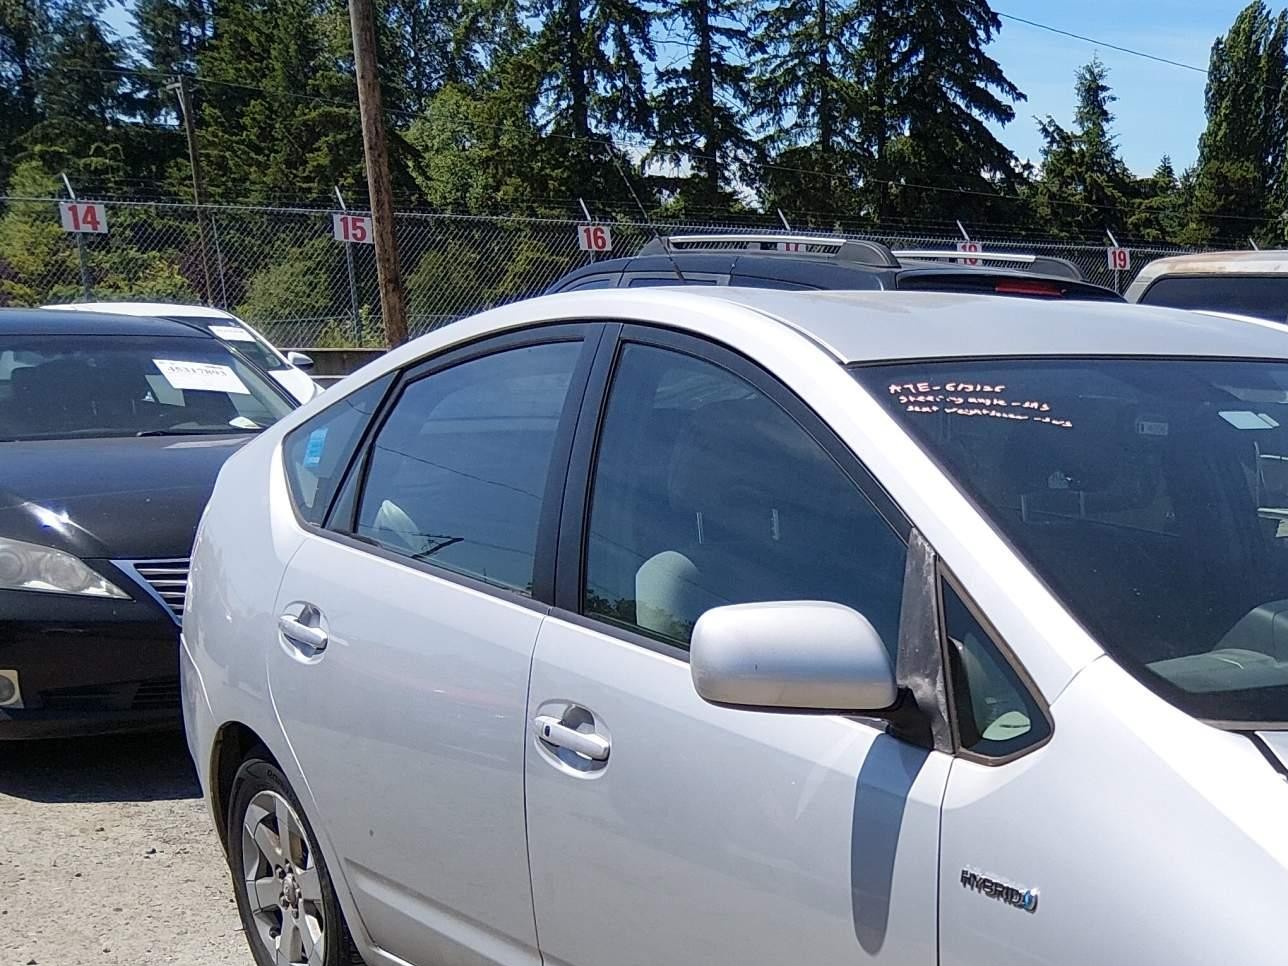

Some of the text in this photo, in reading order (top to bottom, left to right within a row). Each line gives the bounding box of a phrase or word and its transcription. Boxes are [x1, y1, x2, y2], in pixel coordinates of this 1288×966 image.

[67, 204, 101, 231] 14
[339, 216, 367, 242] 15
[583, 227, 608, 251] 16
[1111, 250, 1128, 269] 19
[960, 868, 1025, 910] HYBRID
